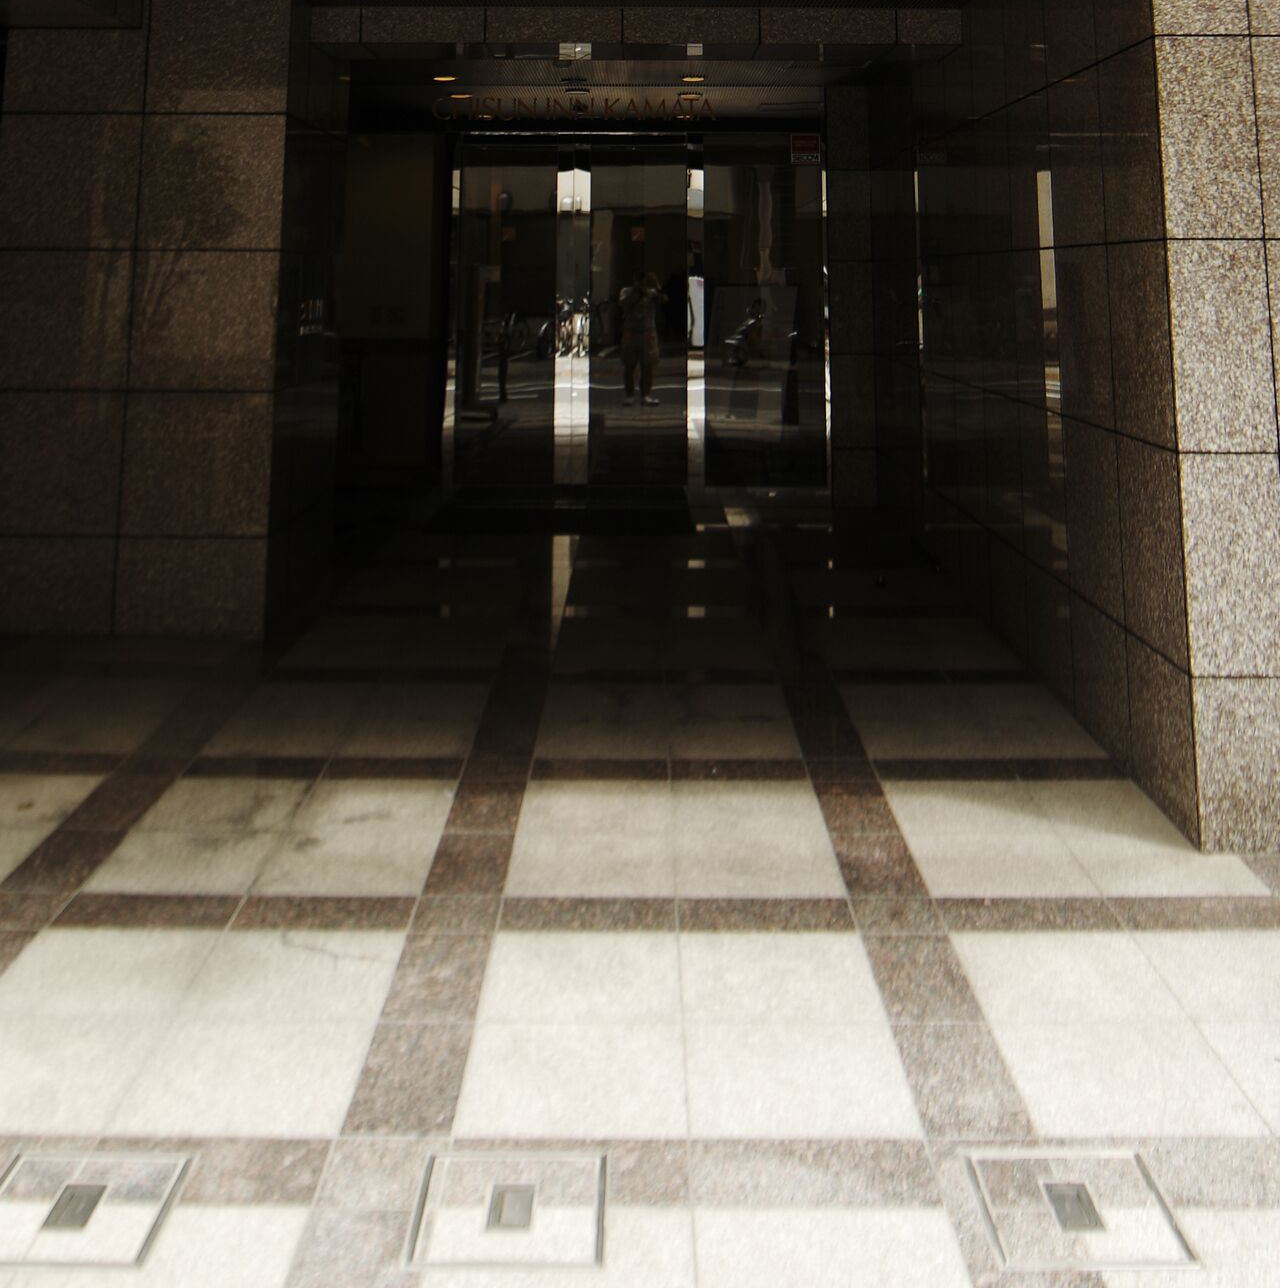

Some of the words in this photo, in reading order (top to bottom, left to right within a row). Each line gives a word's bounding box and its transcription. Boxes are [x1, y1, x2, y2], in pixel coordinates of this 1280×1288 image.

[432, 97, 537, 120] CHISUN
[546, 97, 593, 120] INN
[604, 97, 719, 120] KAMATA
